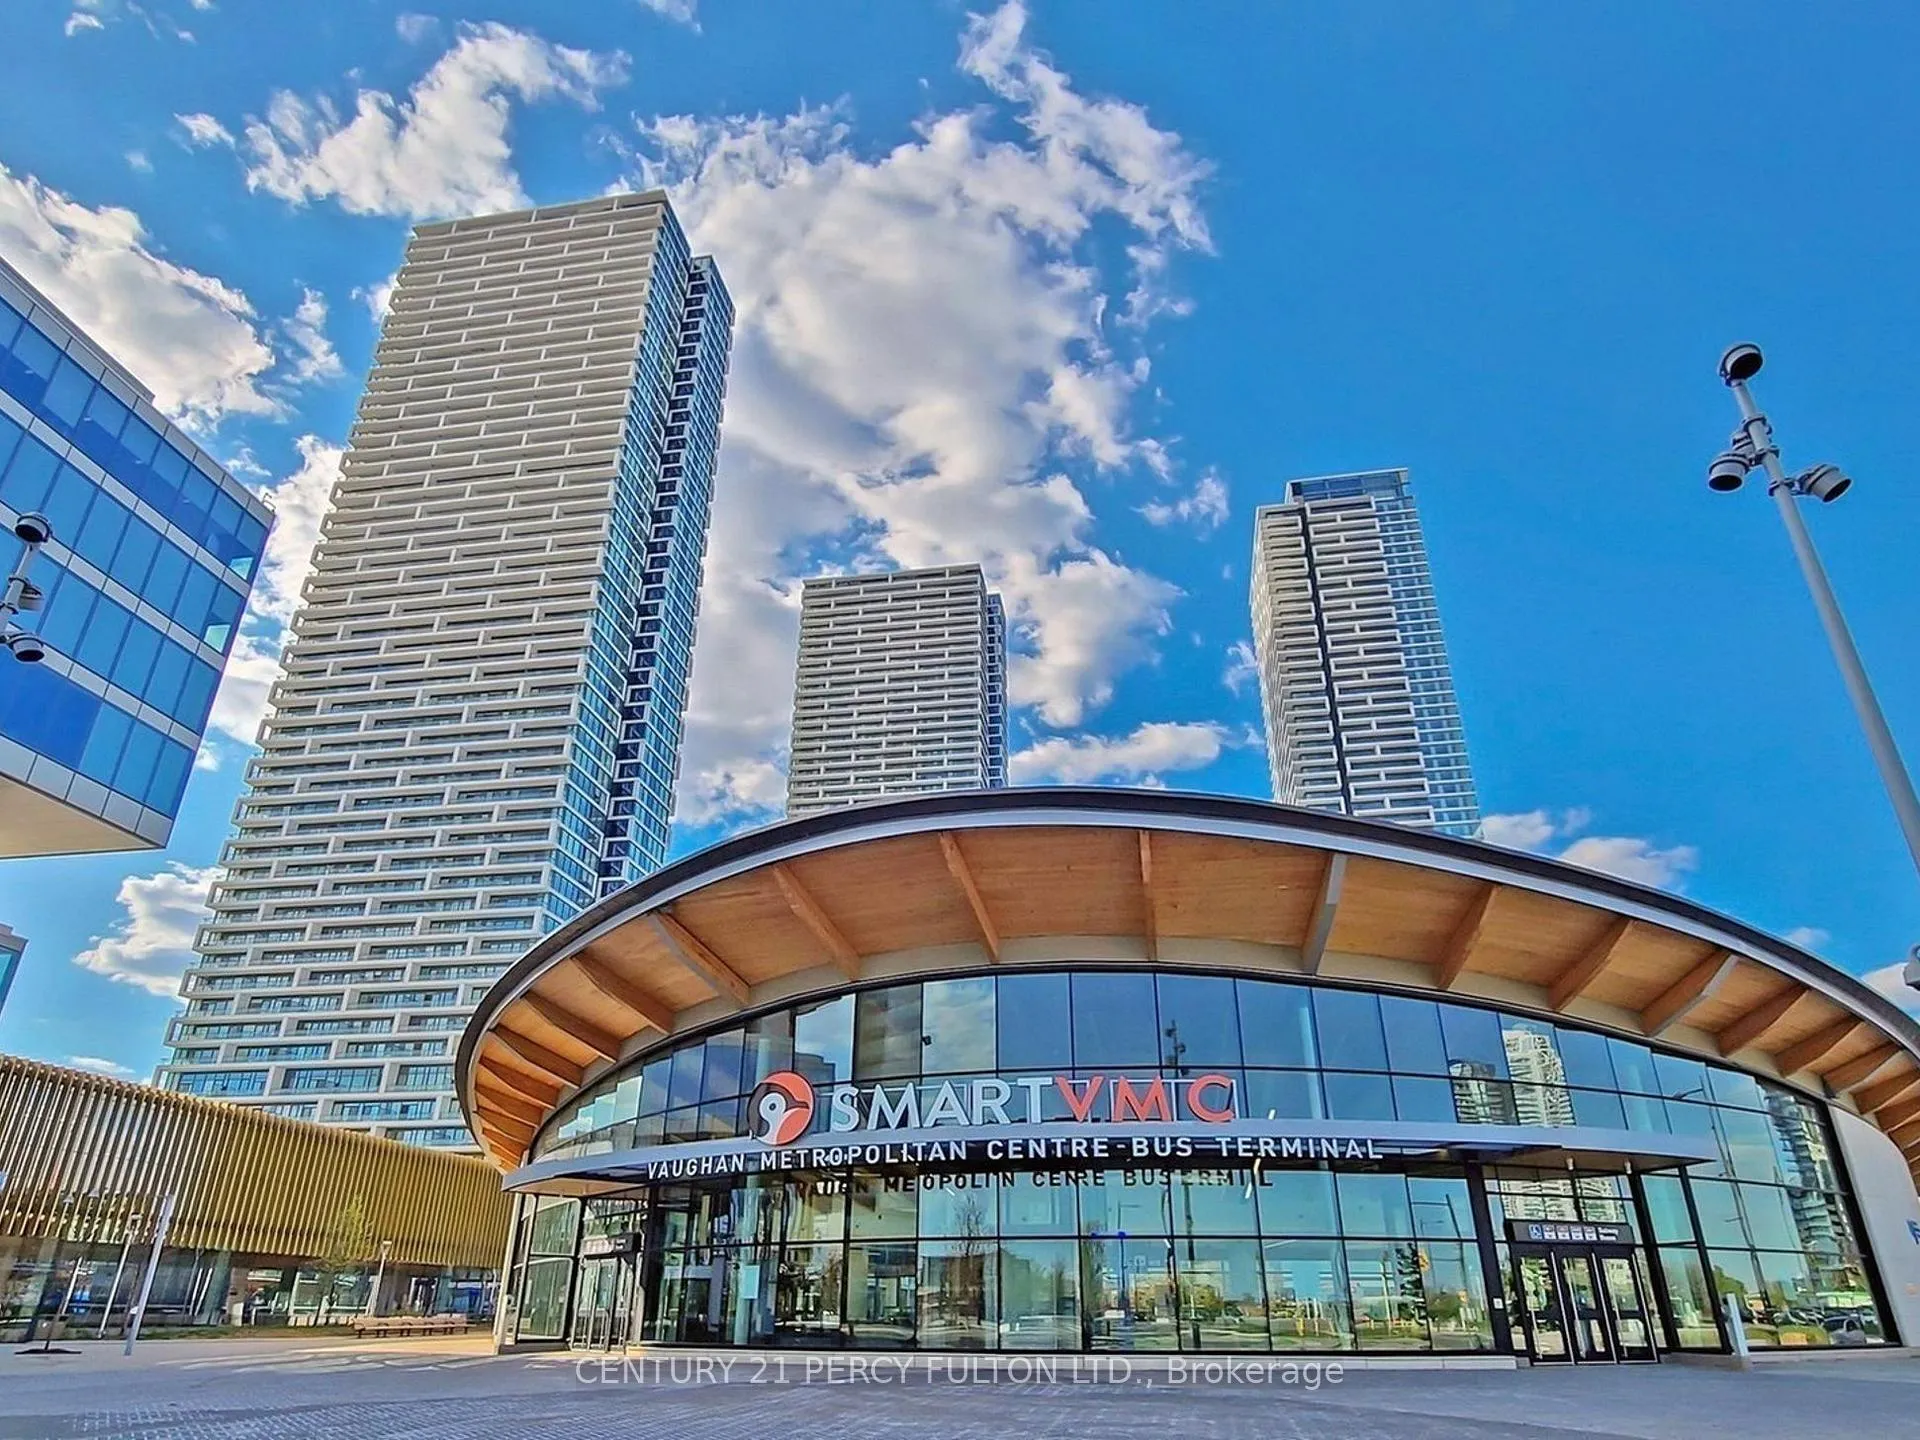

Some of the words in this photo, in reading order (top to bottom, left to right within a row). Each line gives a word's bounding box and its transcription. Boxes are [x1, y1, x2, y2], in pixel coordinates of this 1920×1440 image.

[648, 1154, 744, 1180] VAUGHAN
[760, 1140, 967, 1171] METROPOLITAN
[986, 1138, 1109, 1160] CENTRE
[1132, 1137, 1192, 1158] BUS
[1216, 1137, 1384, 1160] TERMINAL
